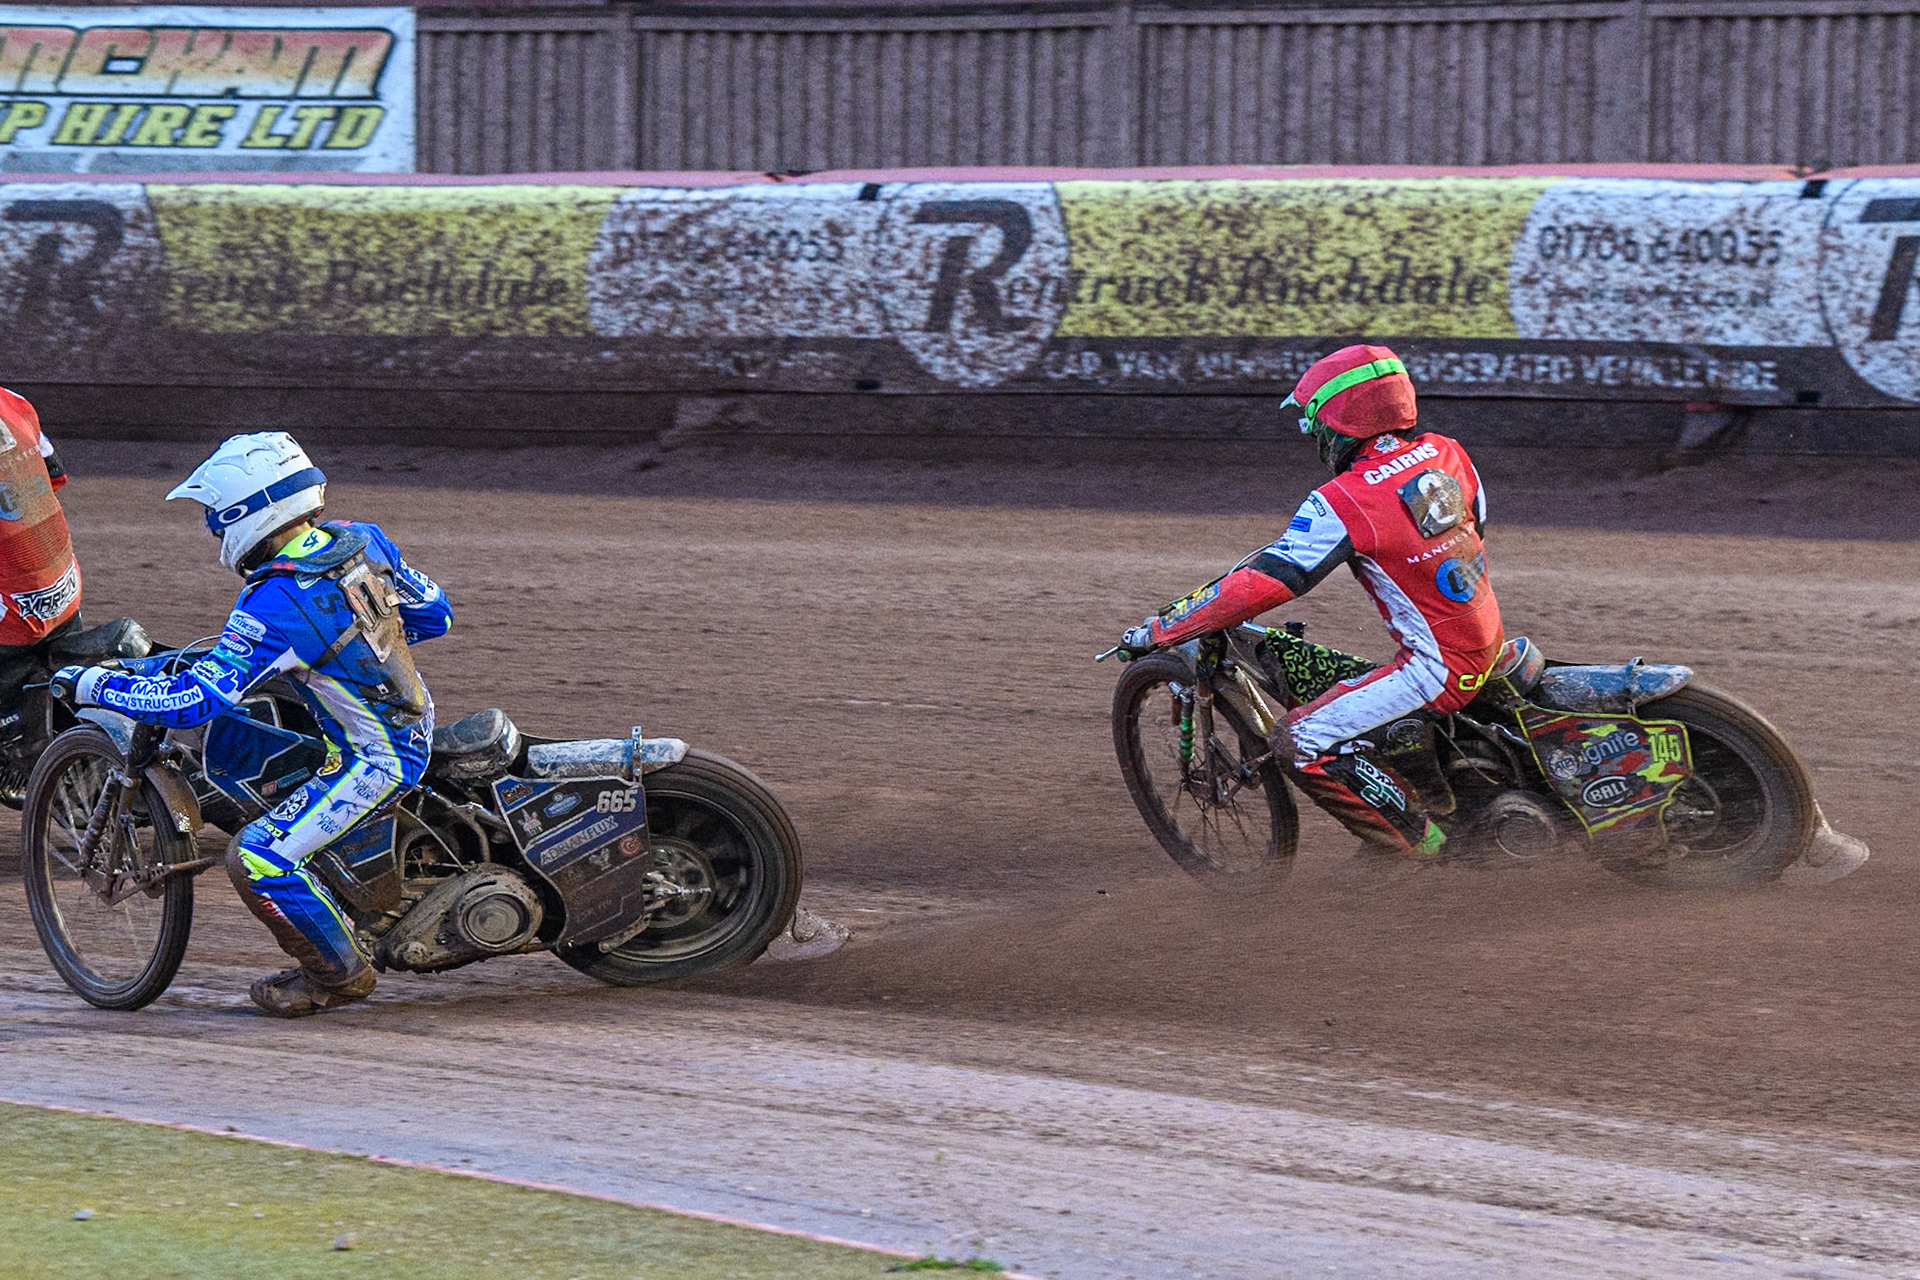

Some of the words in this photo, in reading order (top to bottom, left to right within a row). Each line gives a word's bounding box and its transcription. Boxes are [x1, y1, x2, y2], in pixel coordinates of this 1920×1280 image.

[50, 103, 239, 147] HIRE
[239, 105, 386, 149] LTD
[1650, 228, 1785, 268] 640055
[1363, 442, 1439, 485] CAIRNS
[105, 687, 200, 710] CONSTRUCTION
[132, 681, 171, 697] MAY
[1581, 731, 1640, 766] ignite
[1648, 733, 1682, 764] 145
[352, 786, 372, 801] FLUX
[596, 788, 640, 814] 665
[317, 821, 336, 836] FLUX
[540, 828, 589, 866] ADRIAN
[586, 814, 619, 840] FLUX
